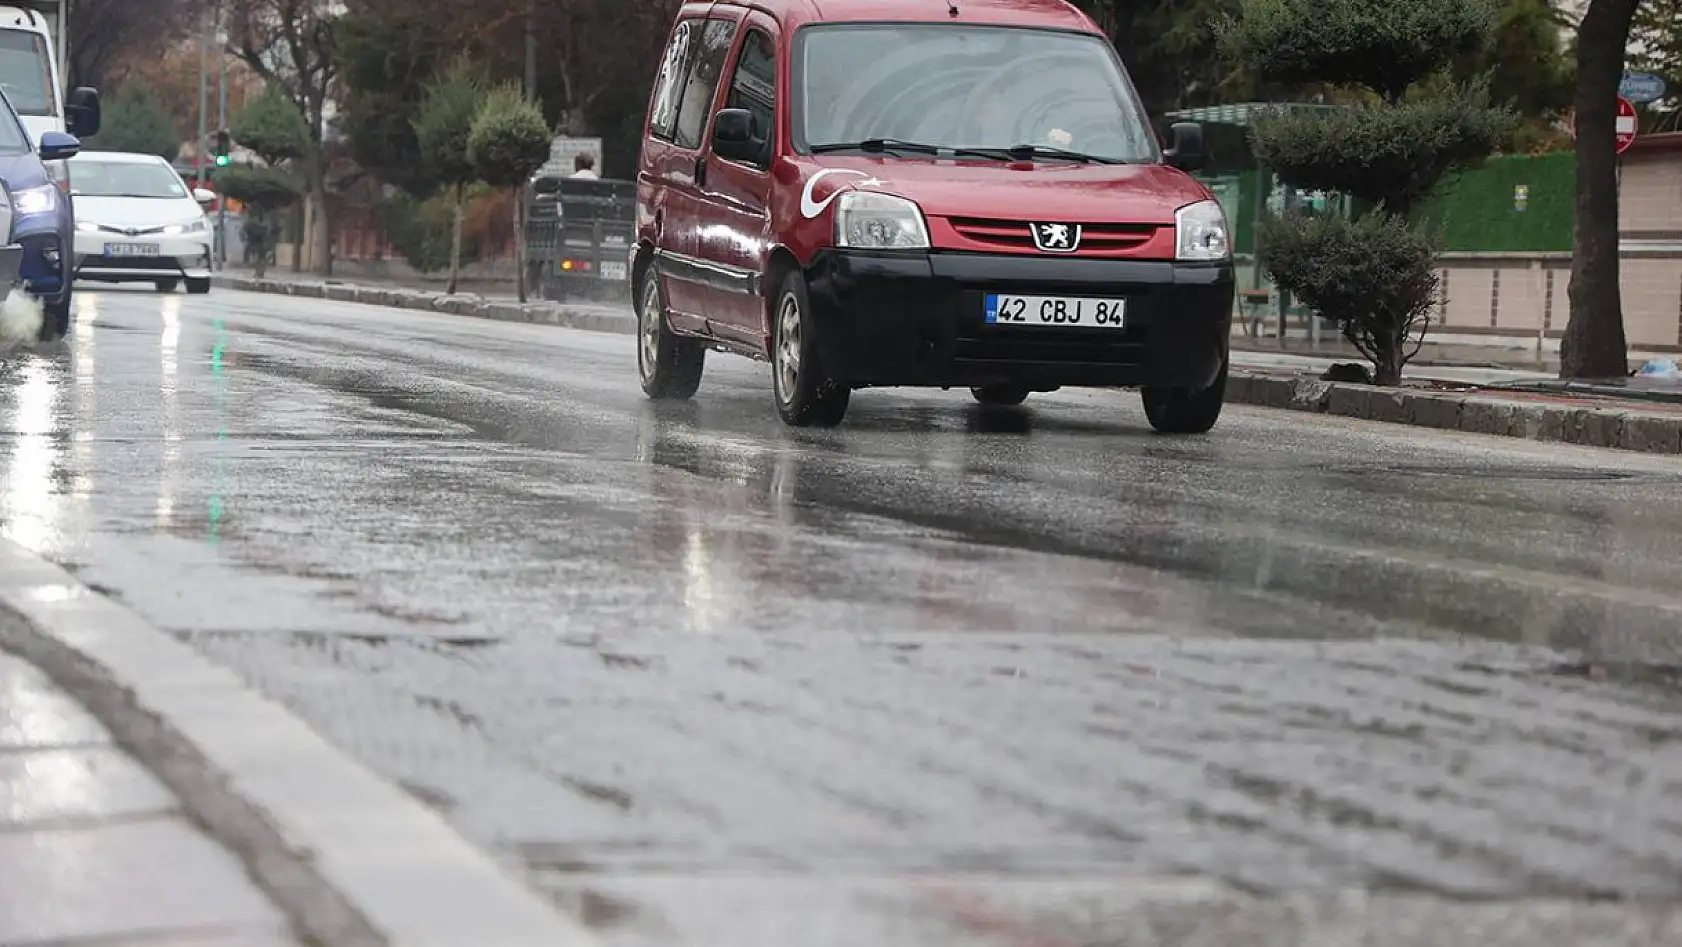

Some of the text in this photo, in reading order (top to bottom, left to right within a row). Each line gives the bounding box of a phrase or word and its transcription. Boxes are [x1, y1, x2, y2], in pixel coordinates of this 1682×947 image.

[999, 298, 1026, 321] 42
[1040, 300, 1081, 323] CBJ
[1095, 302, 1121, 325] 84
